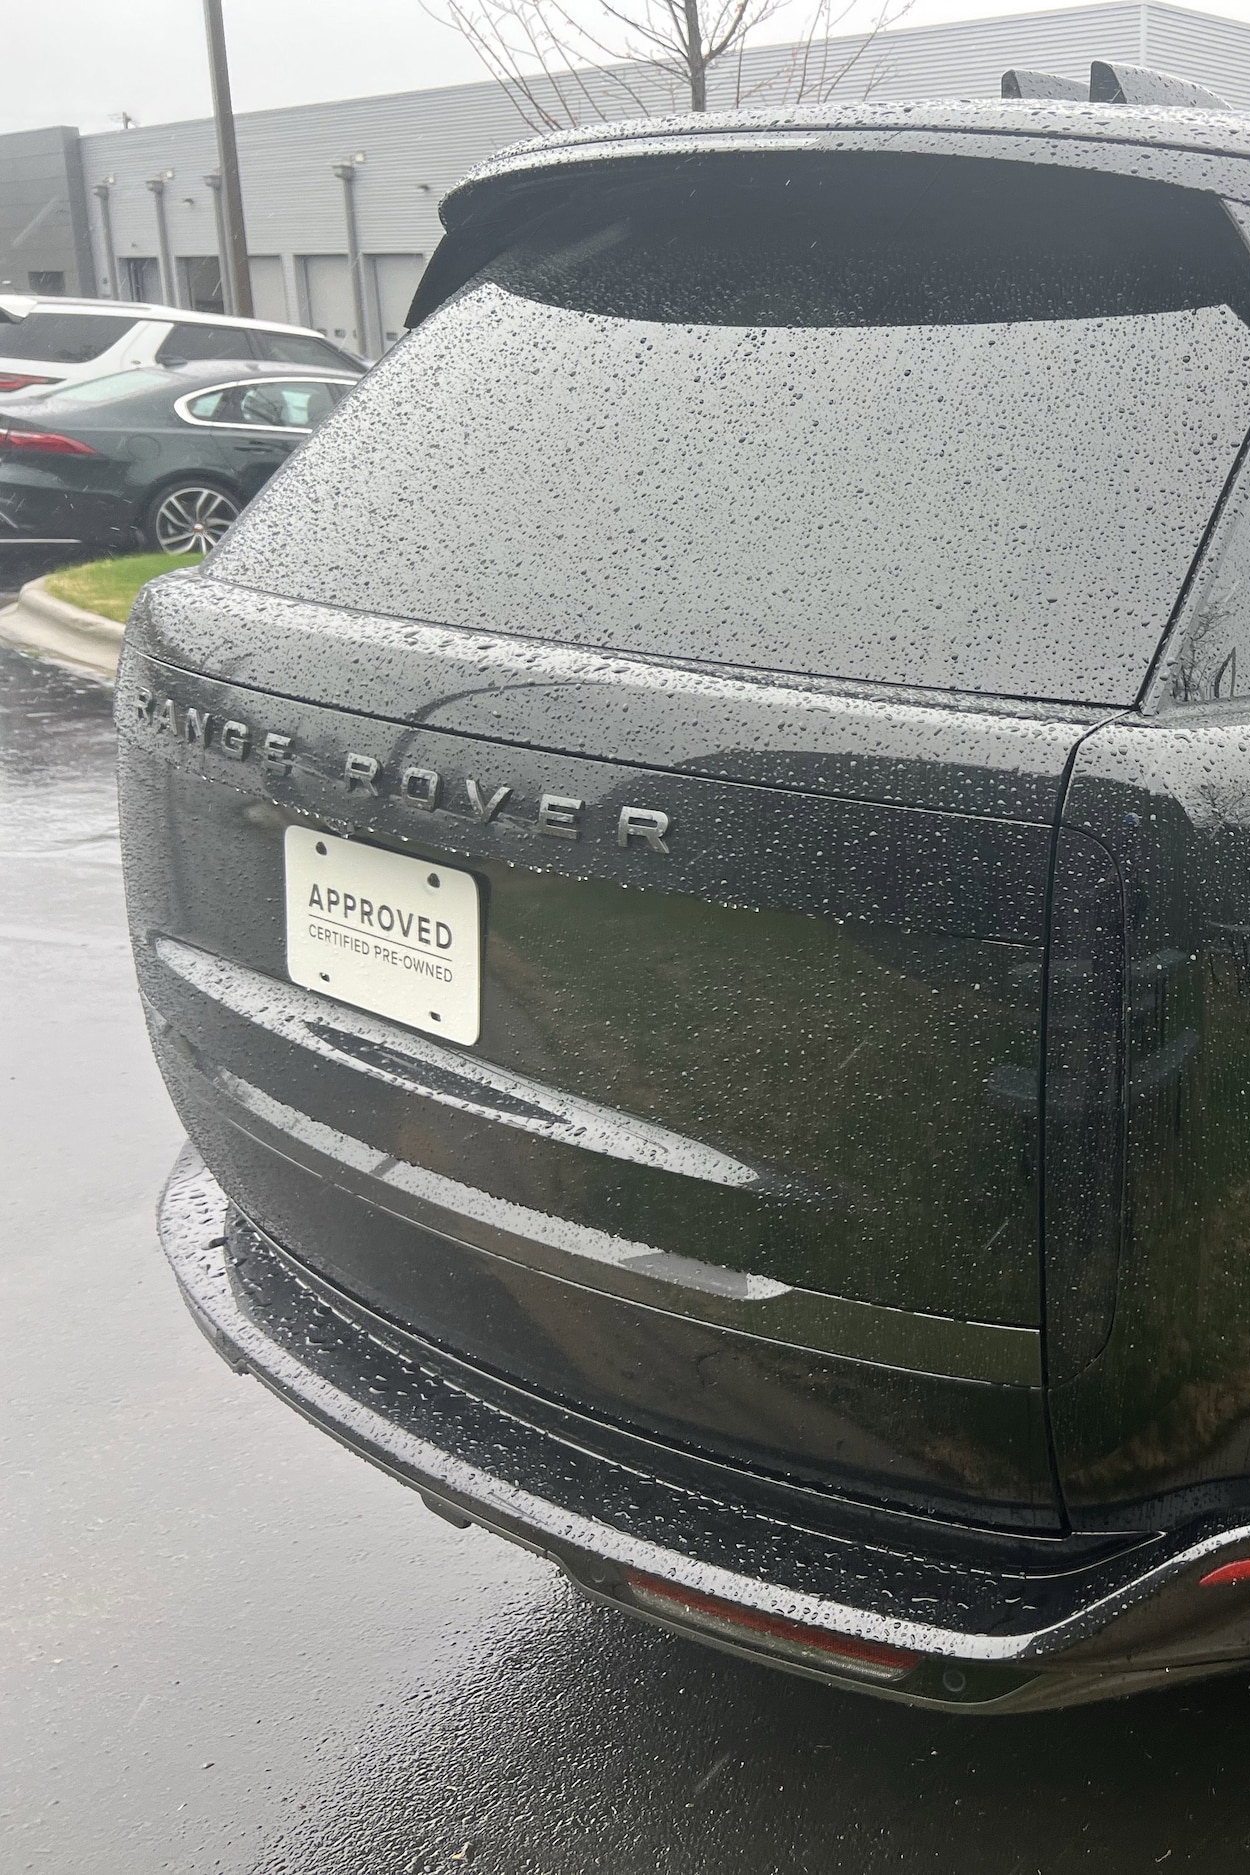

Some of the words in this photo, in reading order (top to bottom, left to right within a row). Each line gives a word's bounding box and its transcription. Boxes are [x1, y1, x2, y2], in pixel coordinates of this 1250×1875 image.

[135, 686, 292, 775] RANGE
[345, 752, 670, 853] ROVER
[309, 883, 453, 950] APPROVED
[308, 924, 370, 955] CERTIFIED
[374, 945, 453, 983] PRE-OWNED
